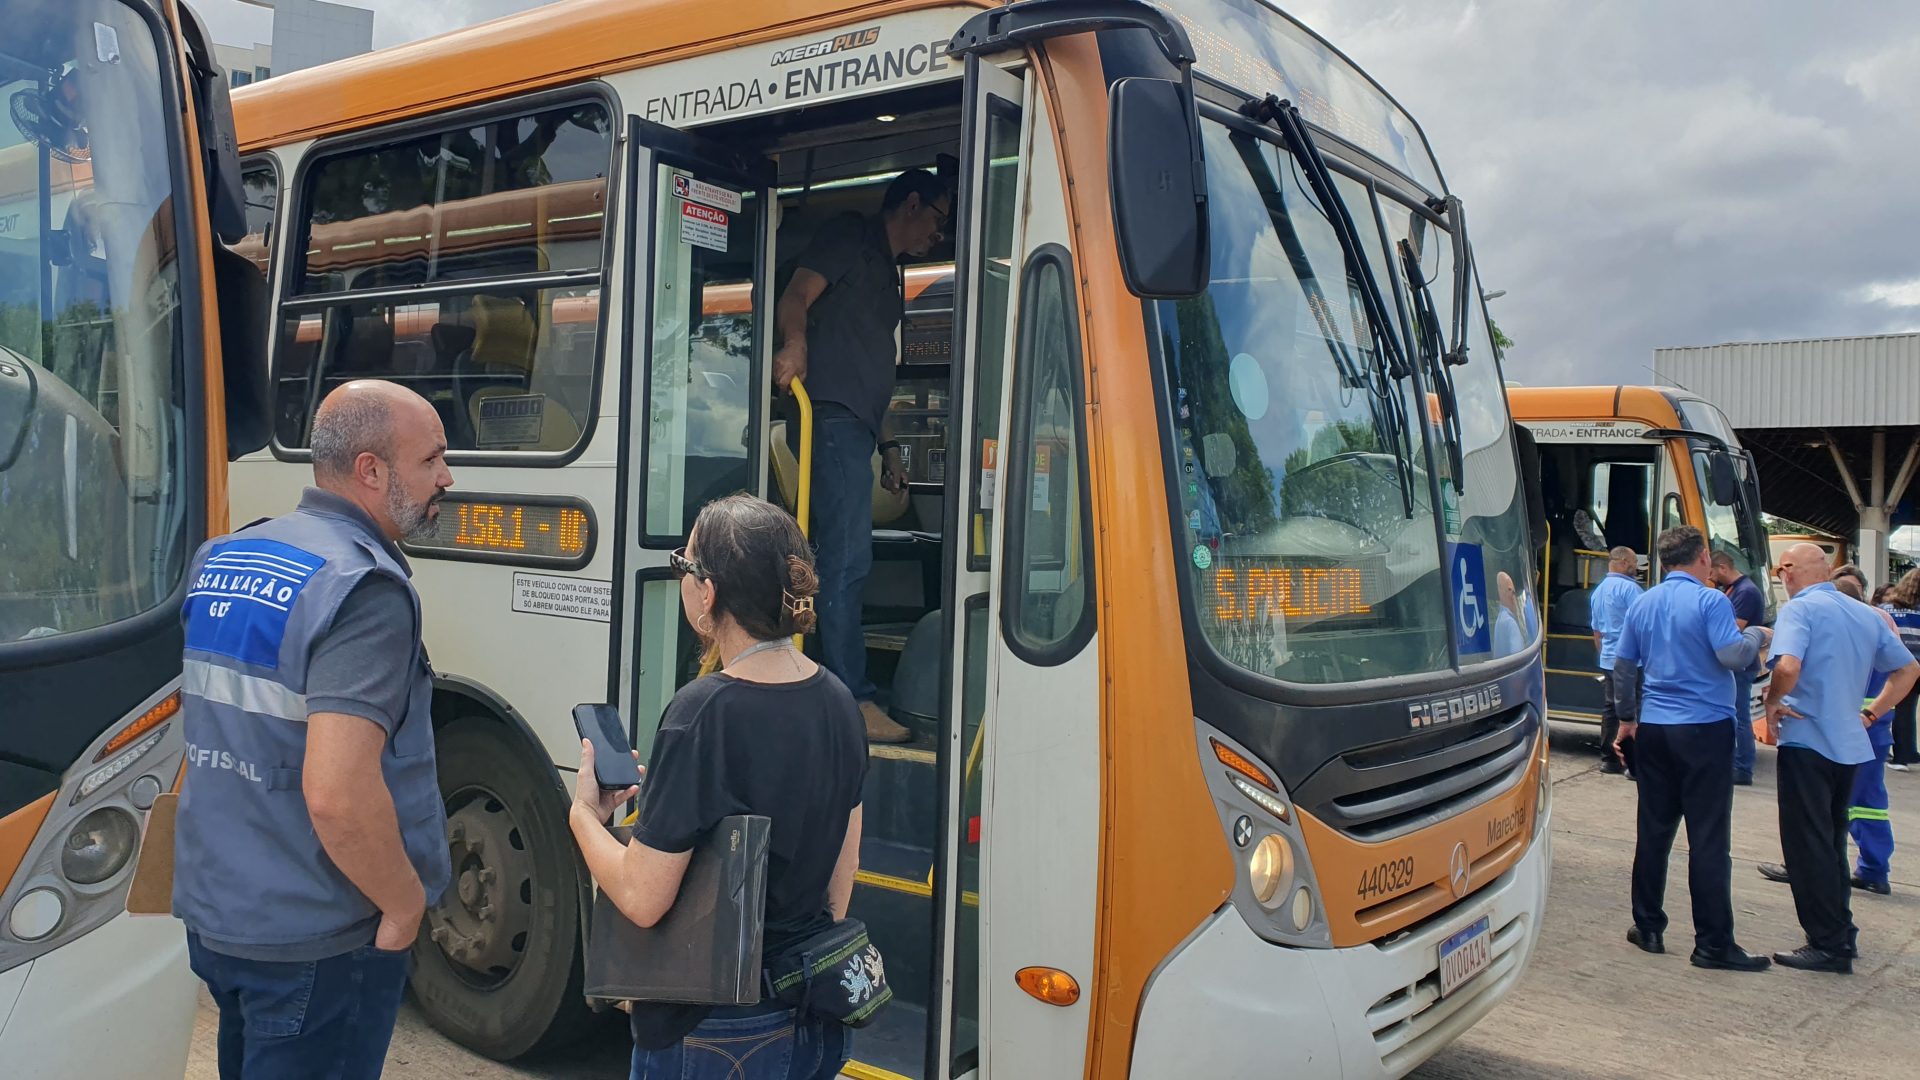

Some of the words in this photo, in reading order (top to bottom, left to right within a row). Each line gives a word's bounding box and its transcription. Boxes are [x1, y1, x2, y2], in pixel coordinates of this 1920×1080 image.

[771, 26, 881, 66] MEGAPLUS
[645, 78, 763, 123] ENTRADA
[785, 39, 950, 100] ENTRANCE
[686, 205, 725, 223] ATENÇÃO
[1530, 428, 1567, 438] TRADA
[1576, 428, 1642, 438] ENTRANCE
[193, 573, 293, 602] SCALIZAÇÃO
[517, 578, 531, 587] ESTE
[532, 579, 557, 590] VEÍCULO
[557, 583, 577, 592] CONTA
[578, 584, 592, 593] COM
[593, 586, 612, 596] SISTE
[522, 589, 530, 597] DE
[531, 590, 561, 600] BLOQUEIO
[561, 593, 574, 602] DAS
[575, 595, 600, 606] PORTAS,
[600, 598, 611, 607] QU
[523, 598, 532, 608] SÓ
[533, 601, 553, 611] ABREM
[554, 603, 580, 614] QUANDO
[580, 606, 592, 615] ELE
[593, 608, 610, 617] PARA
[1409, 683, 1502, 728] NEOBUS
[1487, 799, 1526, 847] Marechal
[1357, 855, 1414, 901] 440329
